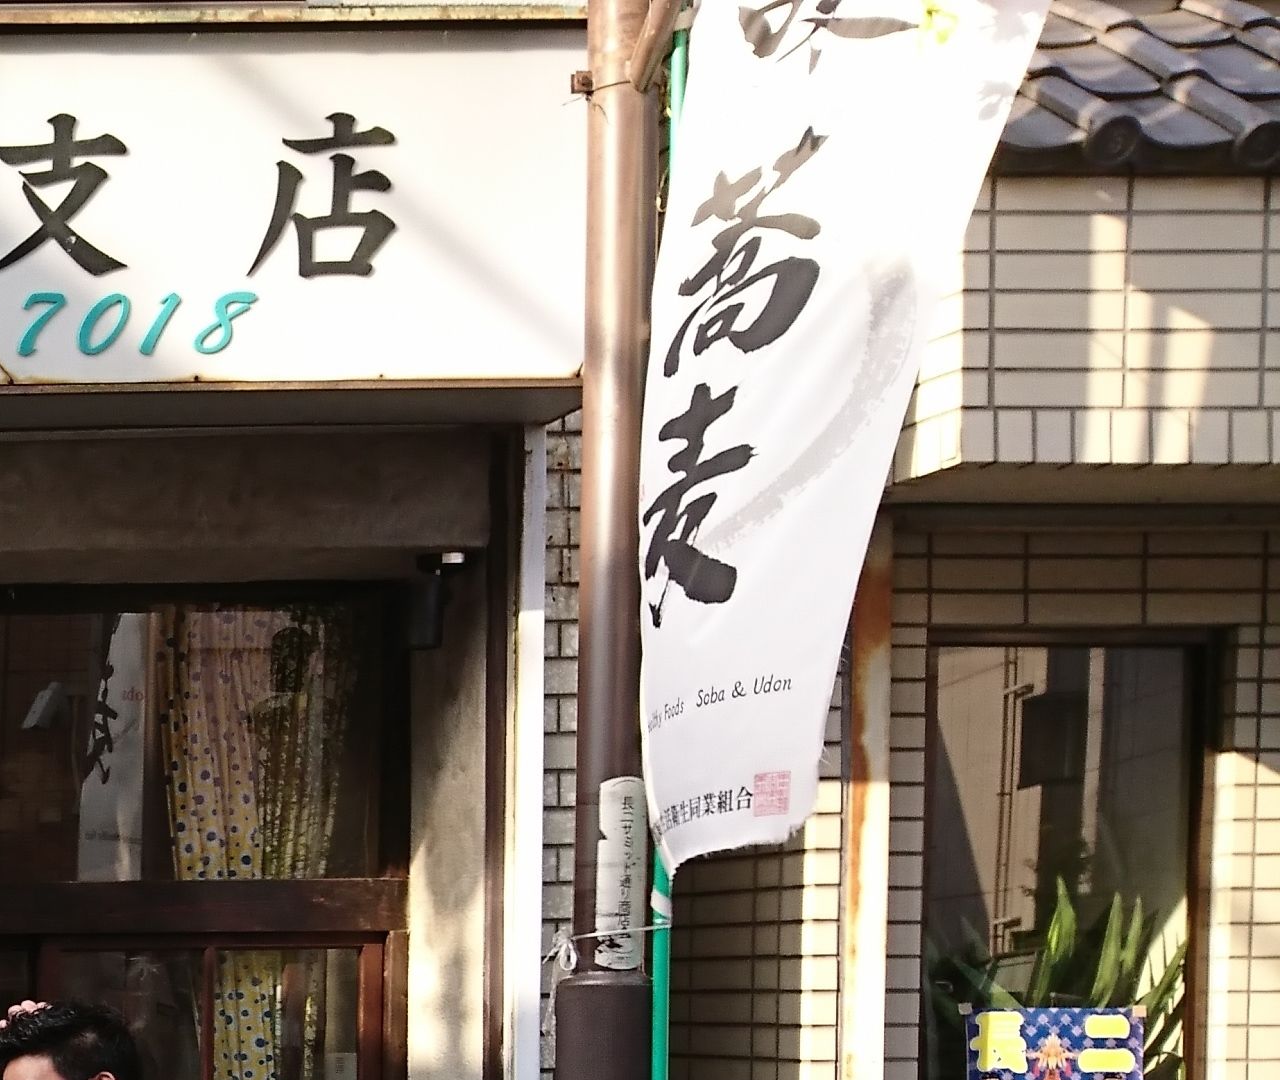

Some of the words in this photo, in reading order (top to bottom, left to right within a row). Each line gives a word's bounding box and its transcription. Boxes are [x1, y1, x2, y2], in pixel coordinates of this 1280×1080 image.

[664, 697, 685, 720] Foods
[696, 686, 725, 708] Soba
[731, 681, 746, 698] &
[753, 674, 792, 695] Udon
